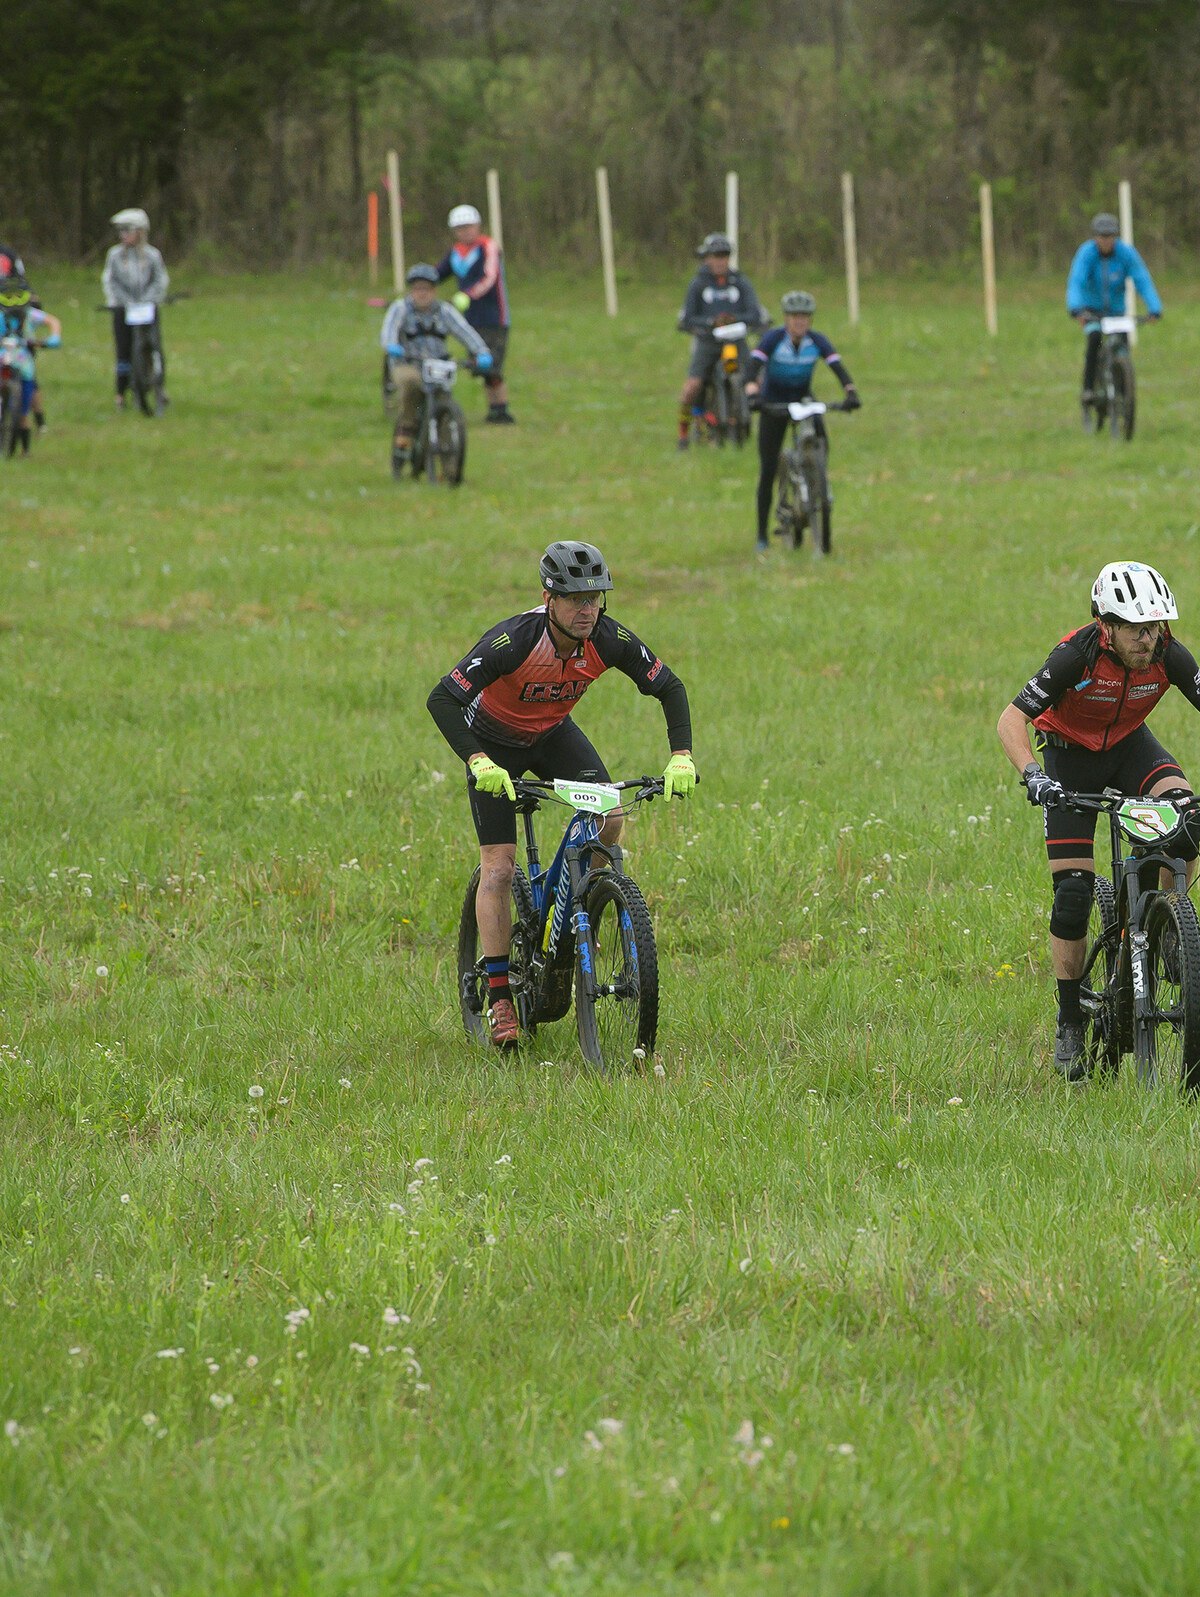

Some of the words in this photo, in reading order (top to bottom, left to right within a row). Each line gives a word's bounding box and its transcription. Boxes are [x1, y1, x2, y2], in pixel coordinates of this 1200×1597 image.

[450, 668, 473, 690] GEAR
[574, 793, 597, 803] 009
[1128, 808, 1169, 834] 3
[1131, 960, 1144, 993] FOX
